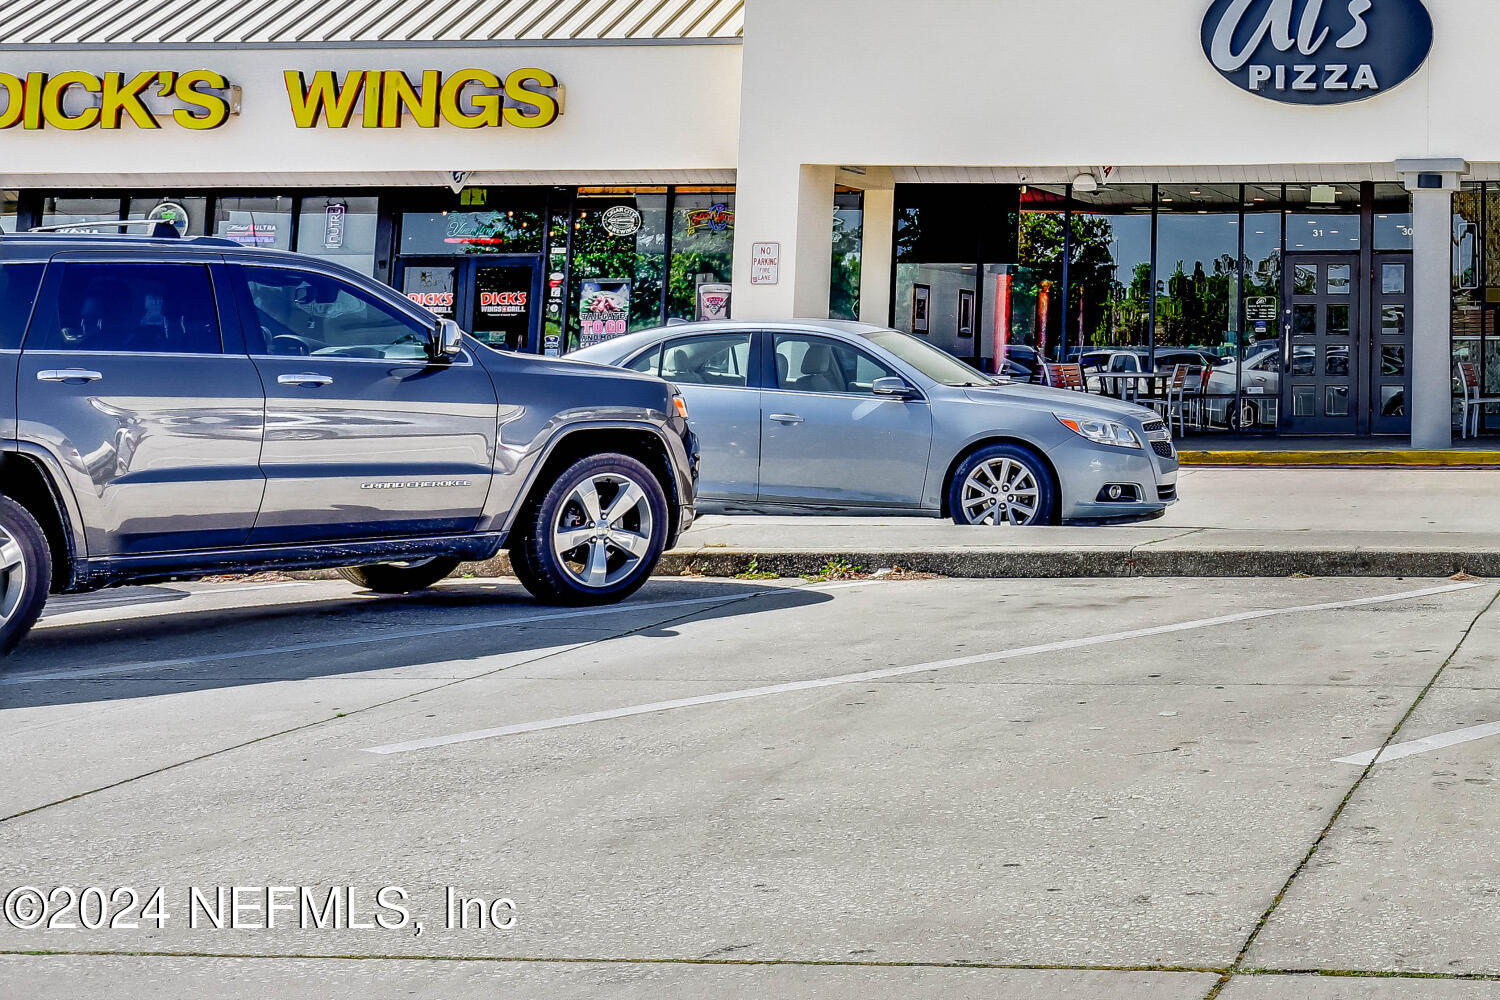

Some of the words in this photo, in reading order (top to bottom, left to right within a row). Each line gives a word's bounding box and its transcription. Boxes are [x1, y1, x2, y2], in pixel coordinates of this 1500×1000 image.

[1248, 64, 1379, 91] PIZZA
[283, 68, 560, 130] WINGS
[607, 225, 637, 234] BREWING
[1312, 229, 1323, 237] 31
[1402, 228, 1413, 236] 30
[760, 247, 771, 255] NO
[753, 258, 777, 266] PARKING
[480, 291, 527, 306] DICK'S
[581, 320, 603, 334] TO
[605, 320, 626, 333] GO
[406, 480, 472, 488] CHEROKEE
